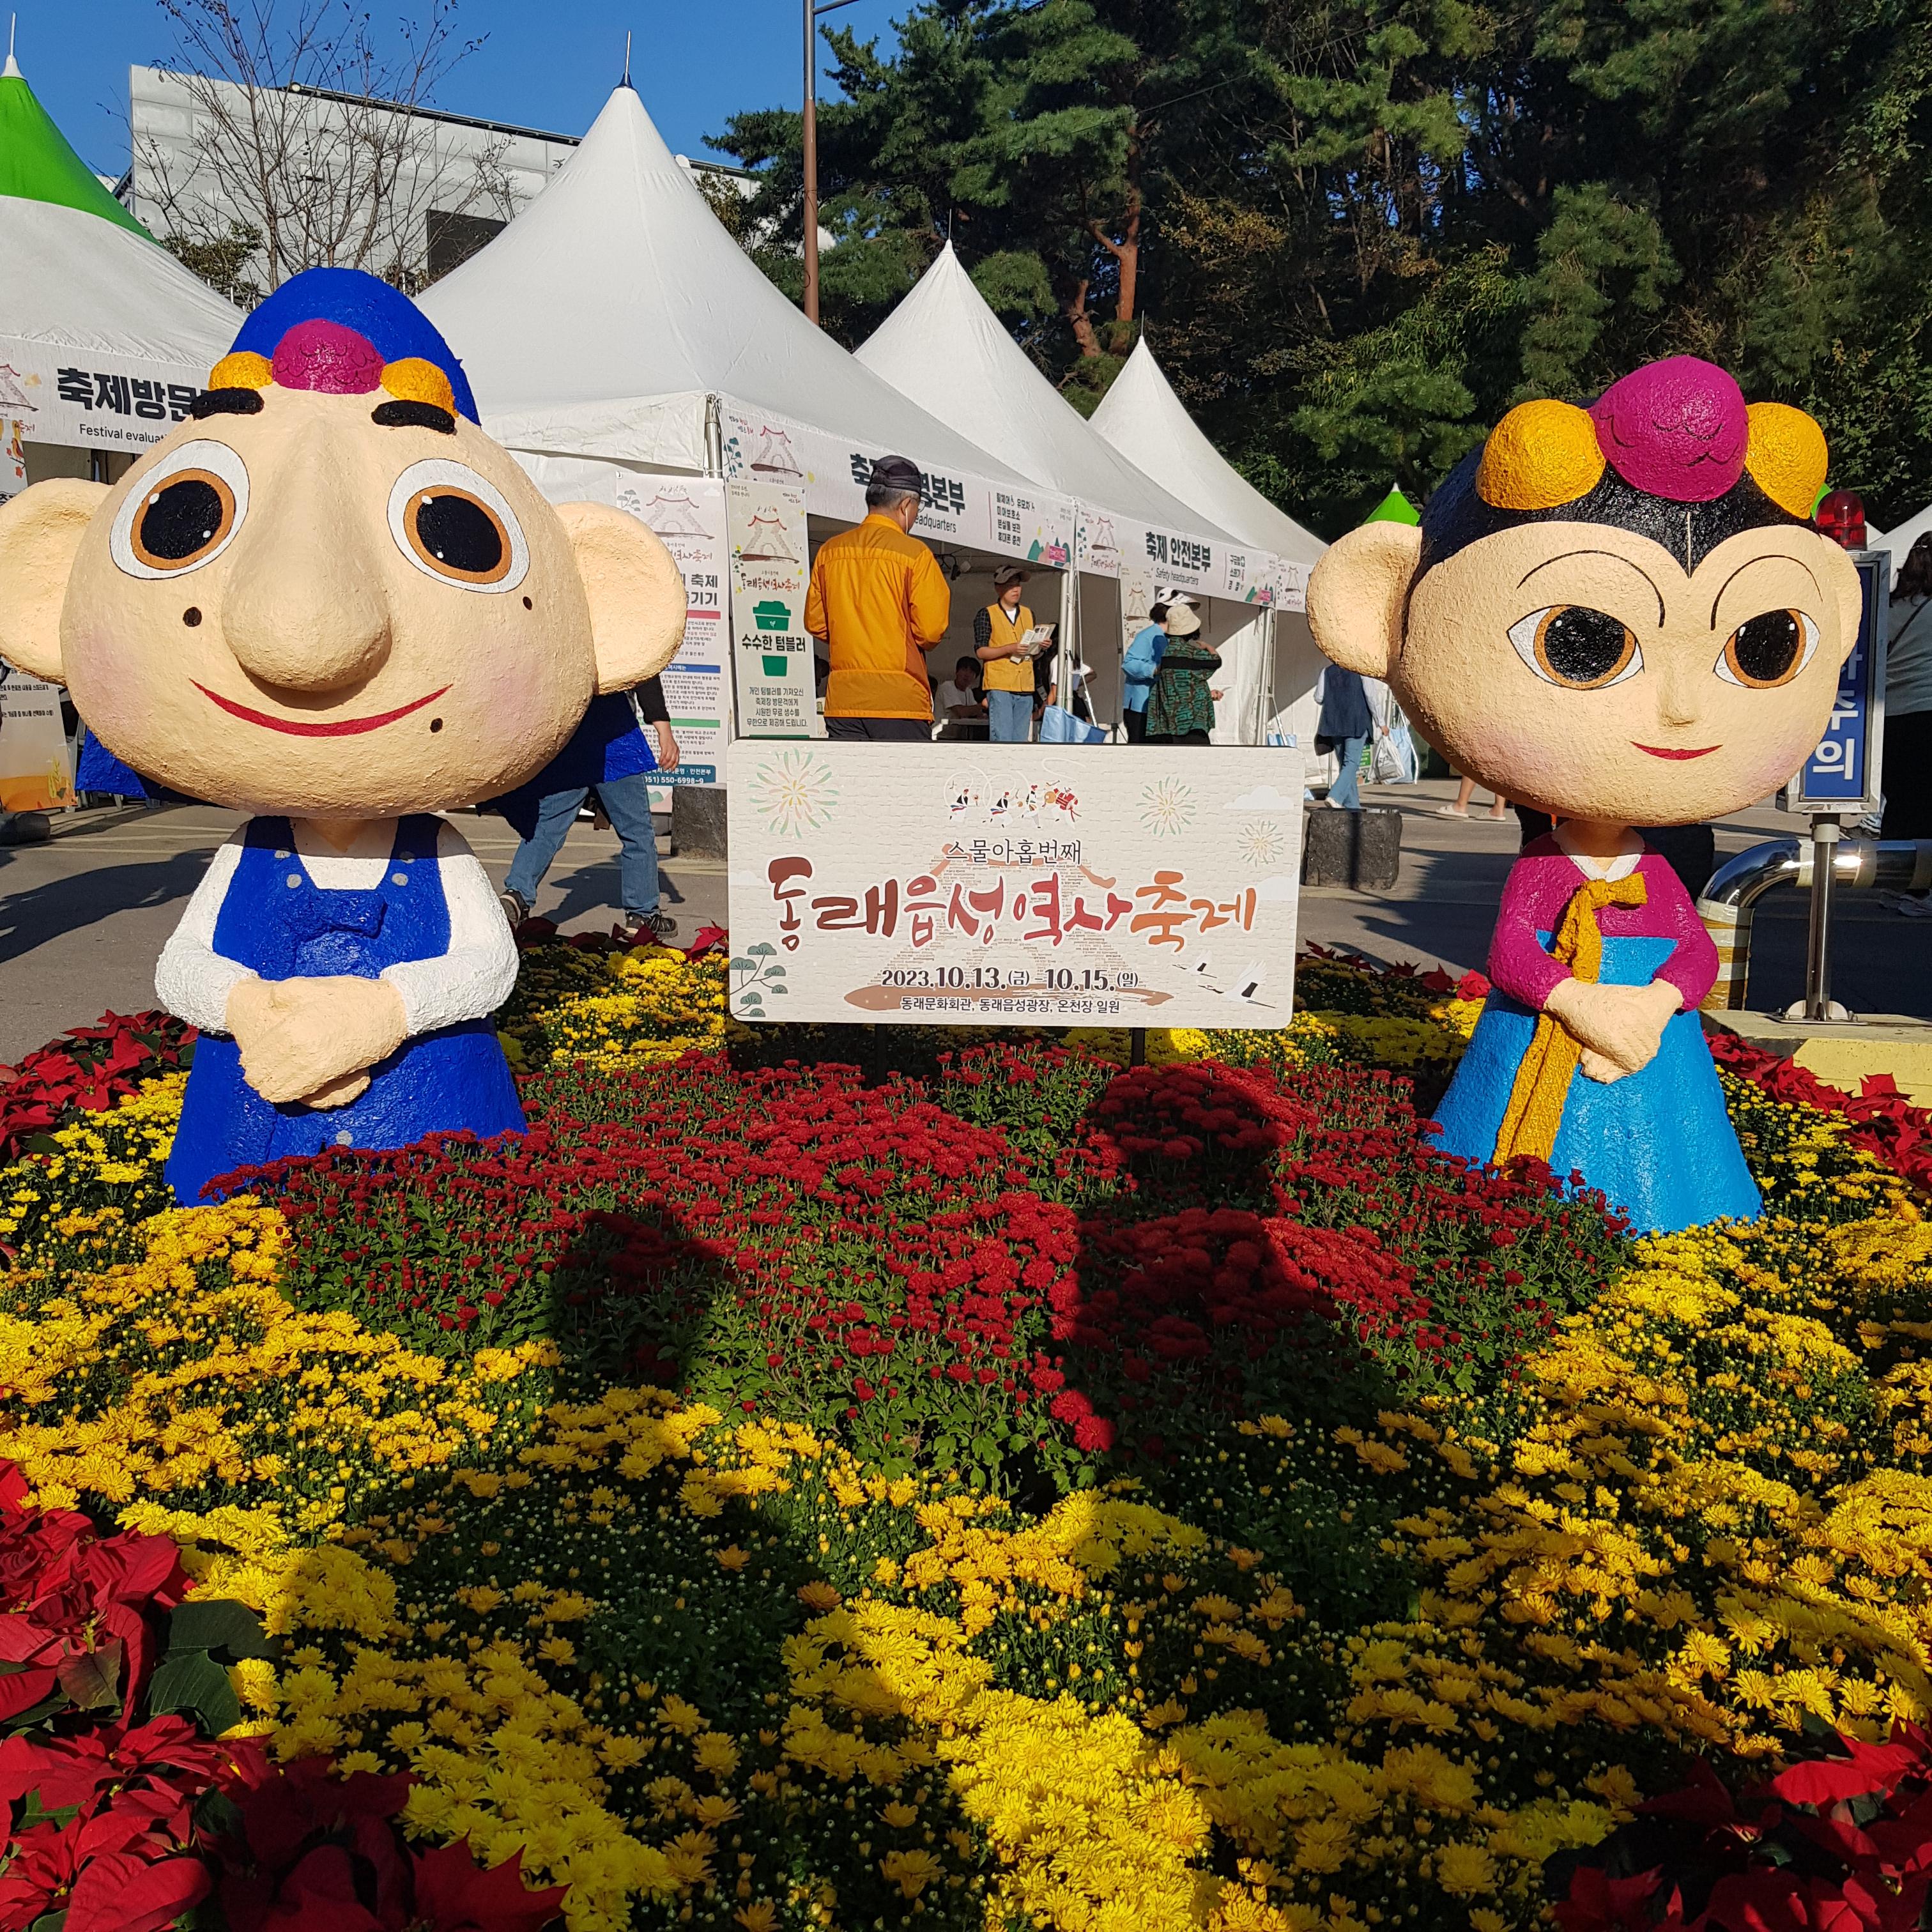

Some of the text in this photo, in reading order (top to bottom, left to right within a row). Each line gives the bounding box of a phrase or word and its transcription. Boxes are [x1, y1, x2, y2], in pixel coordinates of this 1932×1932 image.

[79, 424, 123, 439] Festival
[915, 513, 957, 533] eadquarters
[1146, 531, 1167, 564] 축제
[1170, 537, 1211, 572] 안전본부
[691, 574, 718, 588] 축제
[1156, 567, 1170, 581] Safety
[742, 634, 806, 652] 수수한 텀블러
[749, 687, 804, 696] 개인 텀블러를 가져오신
[756, 708, 800, 717] 시원한 무료 생수를
[747, 718, 767, 726] 무한으로
[769, 718, 785, 727] 제공해
[946, 838, 1081, 865] 스물아홉번째
[901, 997, 1120, 1014] 동래문화회관, 동래읍성광장, 온천장 일원
